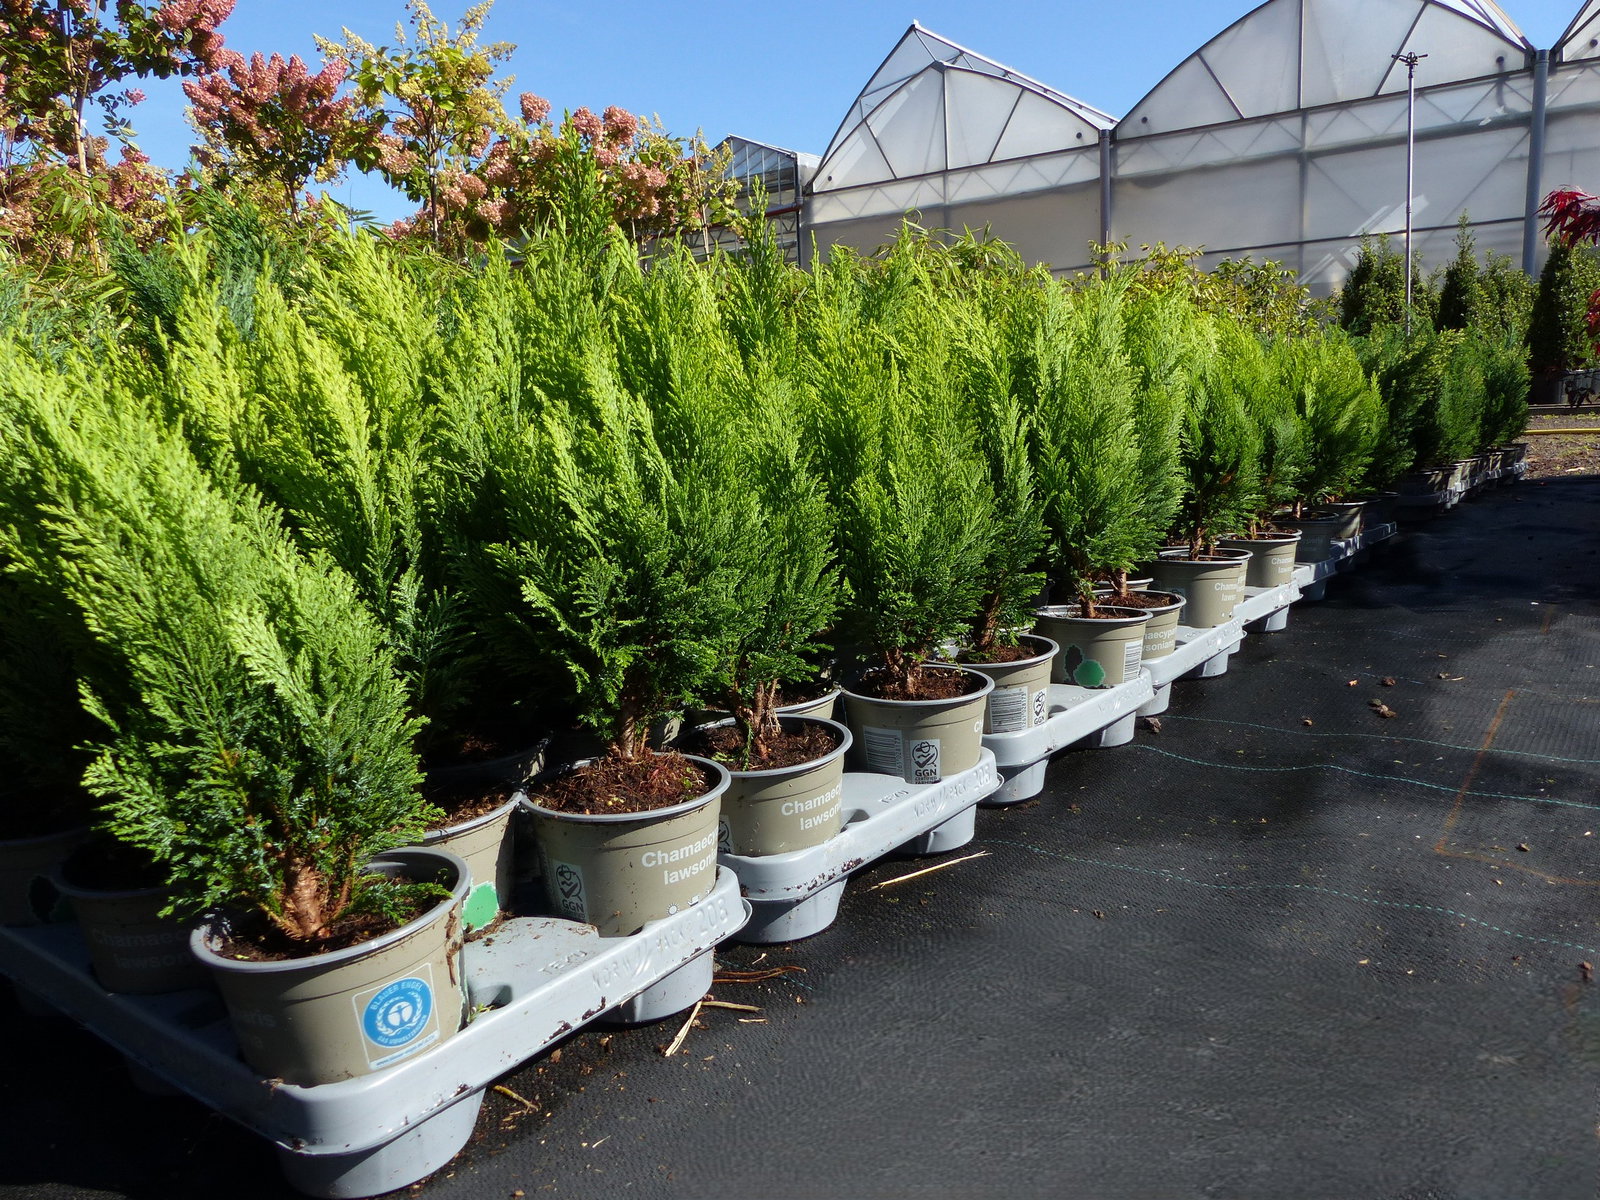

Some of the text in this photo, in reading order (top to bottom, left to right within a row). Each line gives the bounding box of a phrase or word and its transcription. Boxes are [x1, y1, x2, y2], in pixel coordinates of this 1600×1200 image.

[915, 768, 937, 777] GGN
[562, 899, 584, 913] GGN
[696, 898, 729, 936] 208
[371, 981, 423, 1010] BLAUER ENGEL
